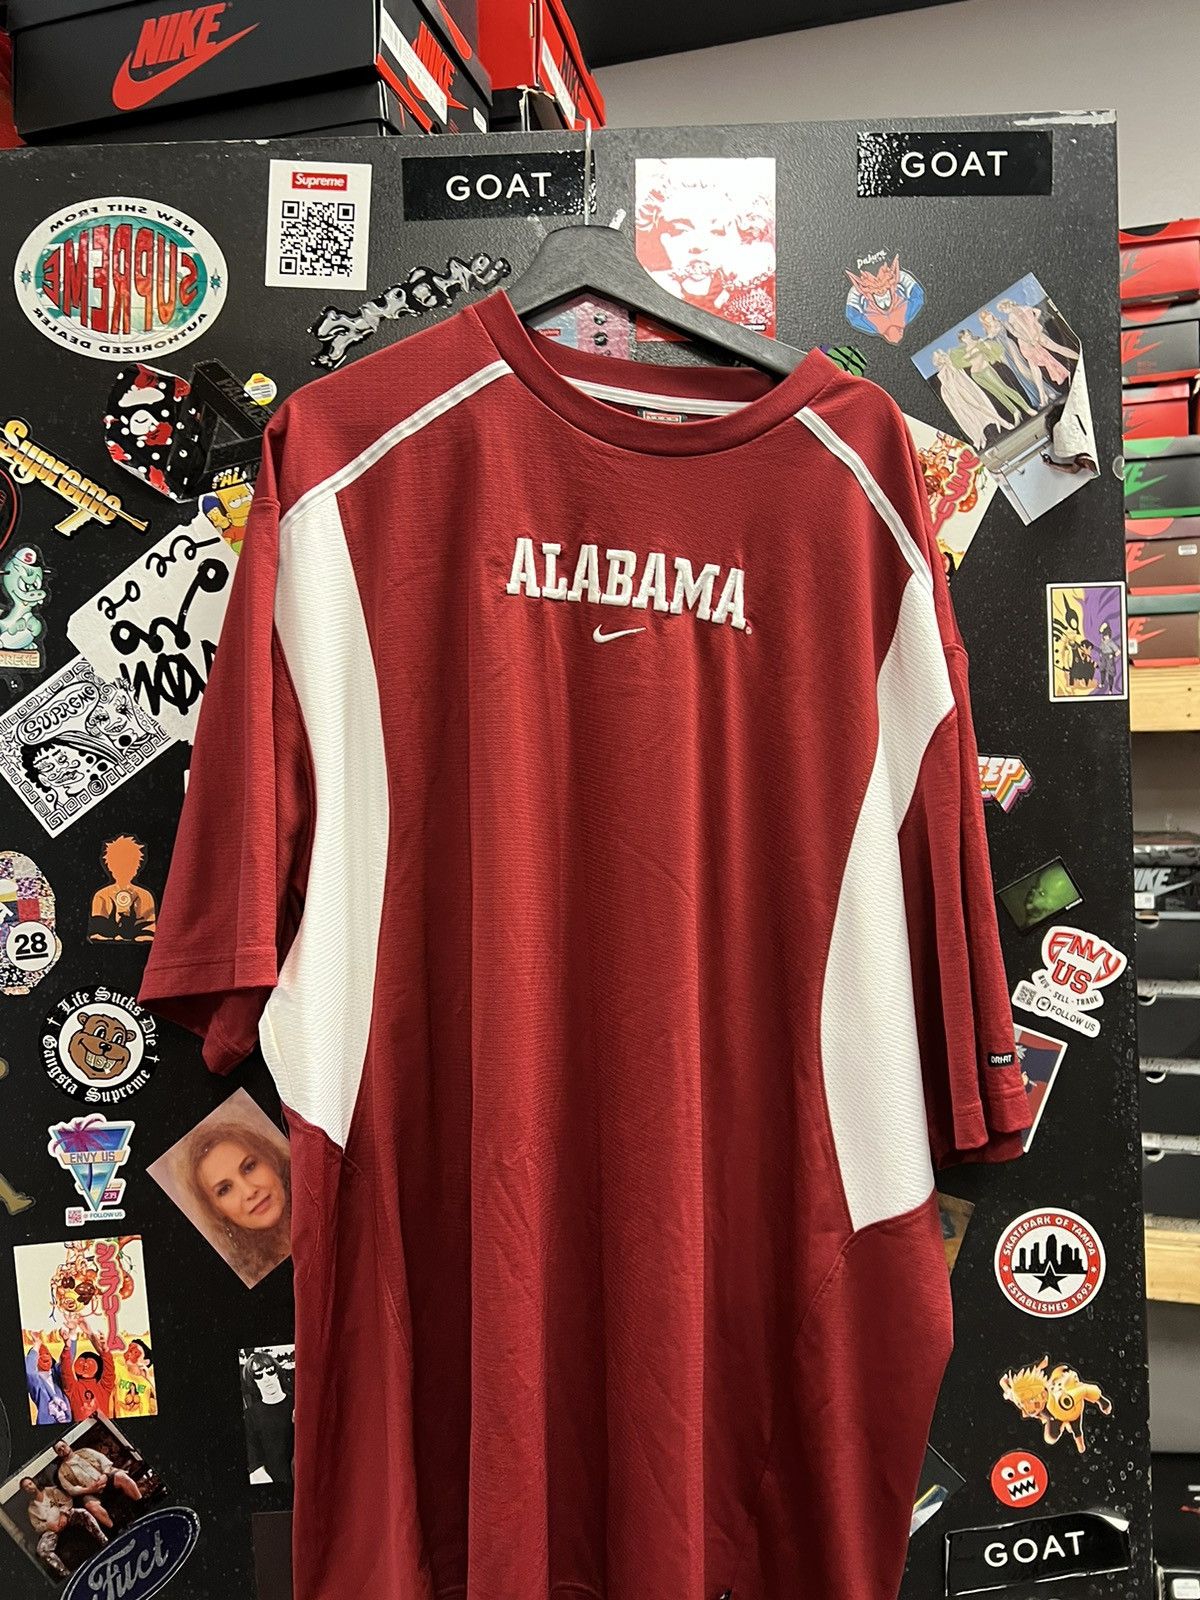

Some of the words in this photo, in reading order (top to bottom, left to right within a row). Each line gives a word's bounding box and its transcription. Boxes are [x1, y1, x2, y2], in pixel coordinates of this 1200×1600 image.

[131, 2, 226, 69] NIKE
[294, 173, 345, 189] Supreme
[901, 150, 1008, 178] GOAT
[446, 172, 552, 201] GOAT
[506, 537, 746, 630] ALABAMA
[23, 686, 95, 741] SUPREME
[14, 932, 48, 956] 28
[1048, 932, 1121, 983] ENVY
[1051, 959, 1092, 994] US
[57, 991, 90, 1015] Life
[94, 986, 145, 1016] Sucks
[139, 1015, 159, 1046] Die
[1052, 991, 1069, 1004] SELL
[1076, 995, 1099, 1006] TRADE
[1050, 1005, 1085, 1026] FOLLOW
[1085, 1021, 1097, 1031] US
[42, 1034, 78, 1095] Gangsta
[85, 1069, 150, 1103] Supreme
[70, 1152, 97, 1163] ENVY
[101, 1151, 116, 1161] US
[1003, 1216, 1051, 1256] SKATEPARK
[1055, 1217, 1069, 1227] OF
[1071, 1224, 1096, 1255] TAMPA
[1007, 1282, 1069, 1312] ESTABLISHED
[1072, 1283, 1093, 1304] 1993
[88, 1529, 169, 1600] Fuct
[984, 1531, 1085, 1567] GOAT
